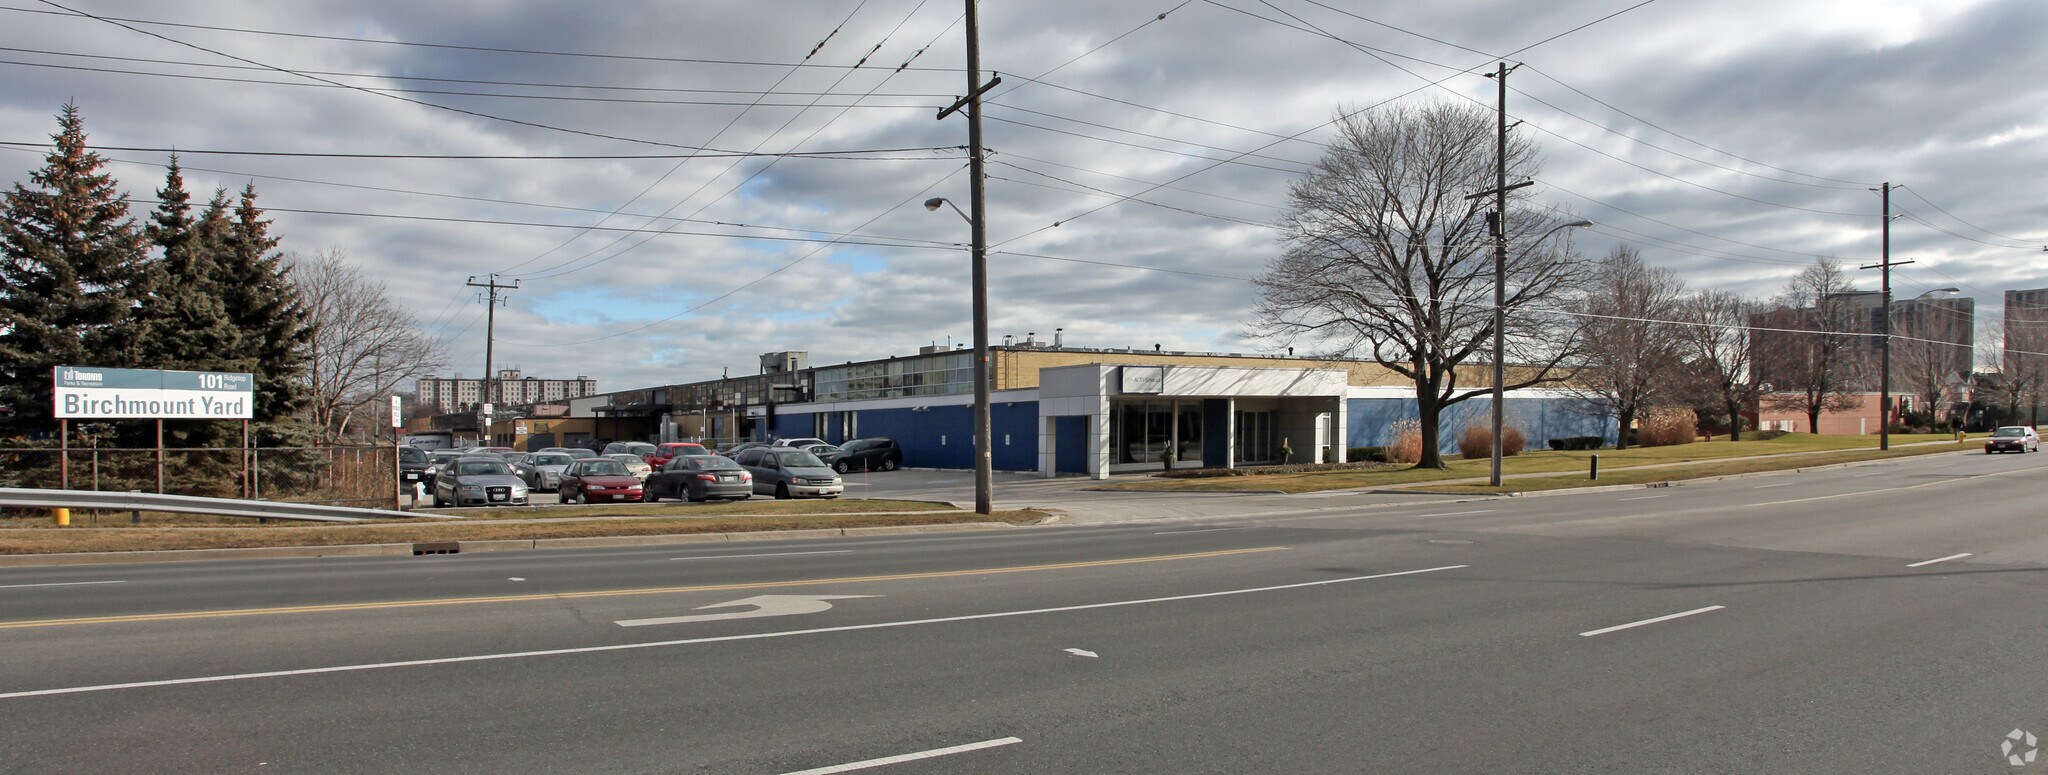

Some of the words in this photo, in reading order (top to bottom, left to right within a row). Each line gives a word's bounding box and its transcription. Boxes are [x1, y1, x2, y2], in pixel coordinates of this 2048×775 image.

[74, 370, 102, 381] TORONTO
[199, 374, 223, 389] 101
[223, 374, 246, 383] Ridgetop
[64, 393, 195, 415] Birchmount
[201, 396, 244, 415] Yard
